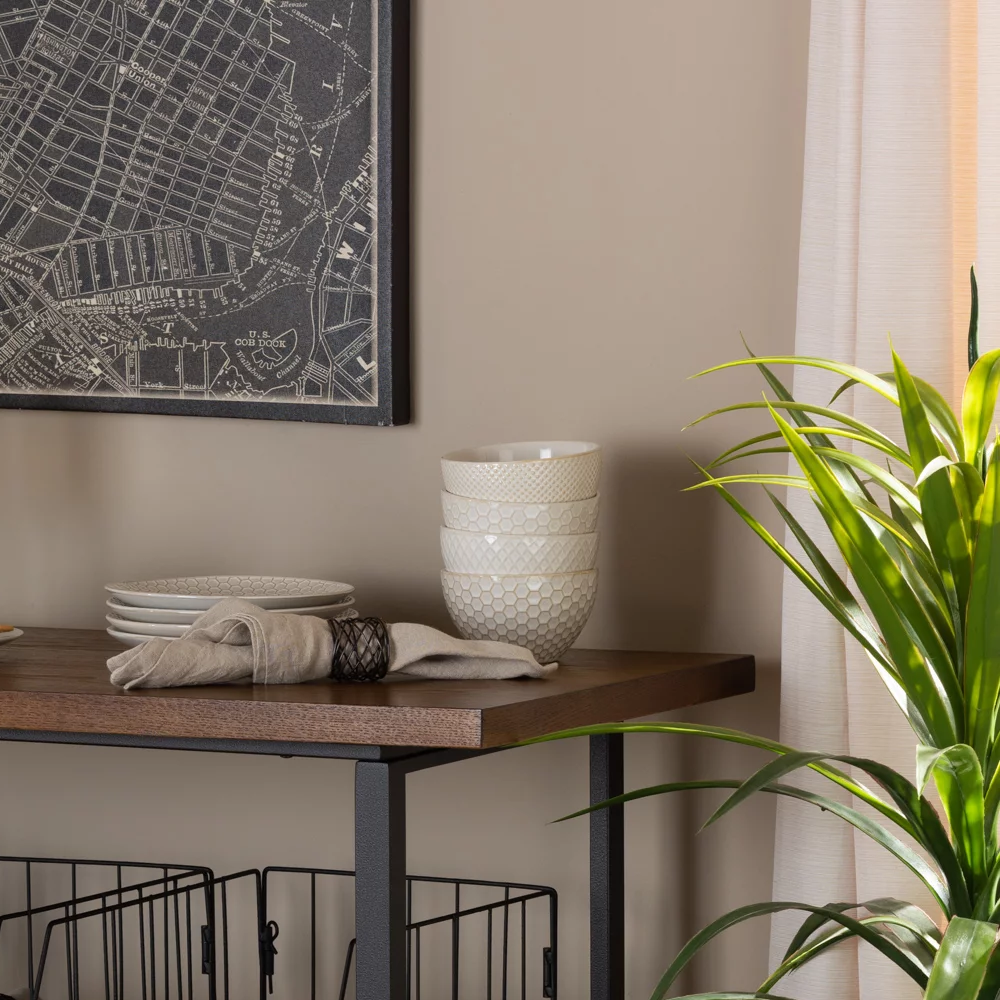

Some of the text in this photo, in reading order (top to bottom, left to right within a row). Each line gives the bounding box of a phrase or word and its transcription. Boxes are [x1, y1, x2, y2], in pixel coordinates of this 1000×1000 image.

[292, 8, 329, 33] GREENPOINT
[37, 33, 76, 58] WASHINGTON
[128, 70, 156, 89] Union
[14, 261, 34, 275] HALL
[90, 342, 113, 364] BRIDGE
[259, 340, 286, 348] DOCK
[236, 350, 266, 382] Wallabout
[276, 355, 302, 379] Channel
